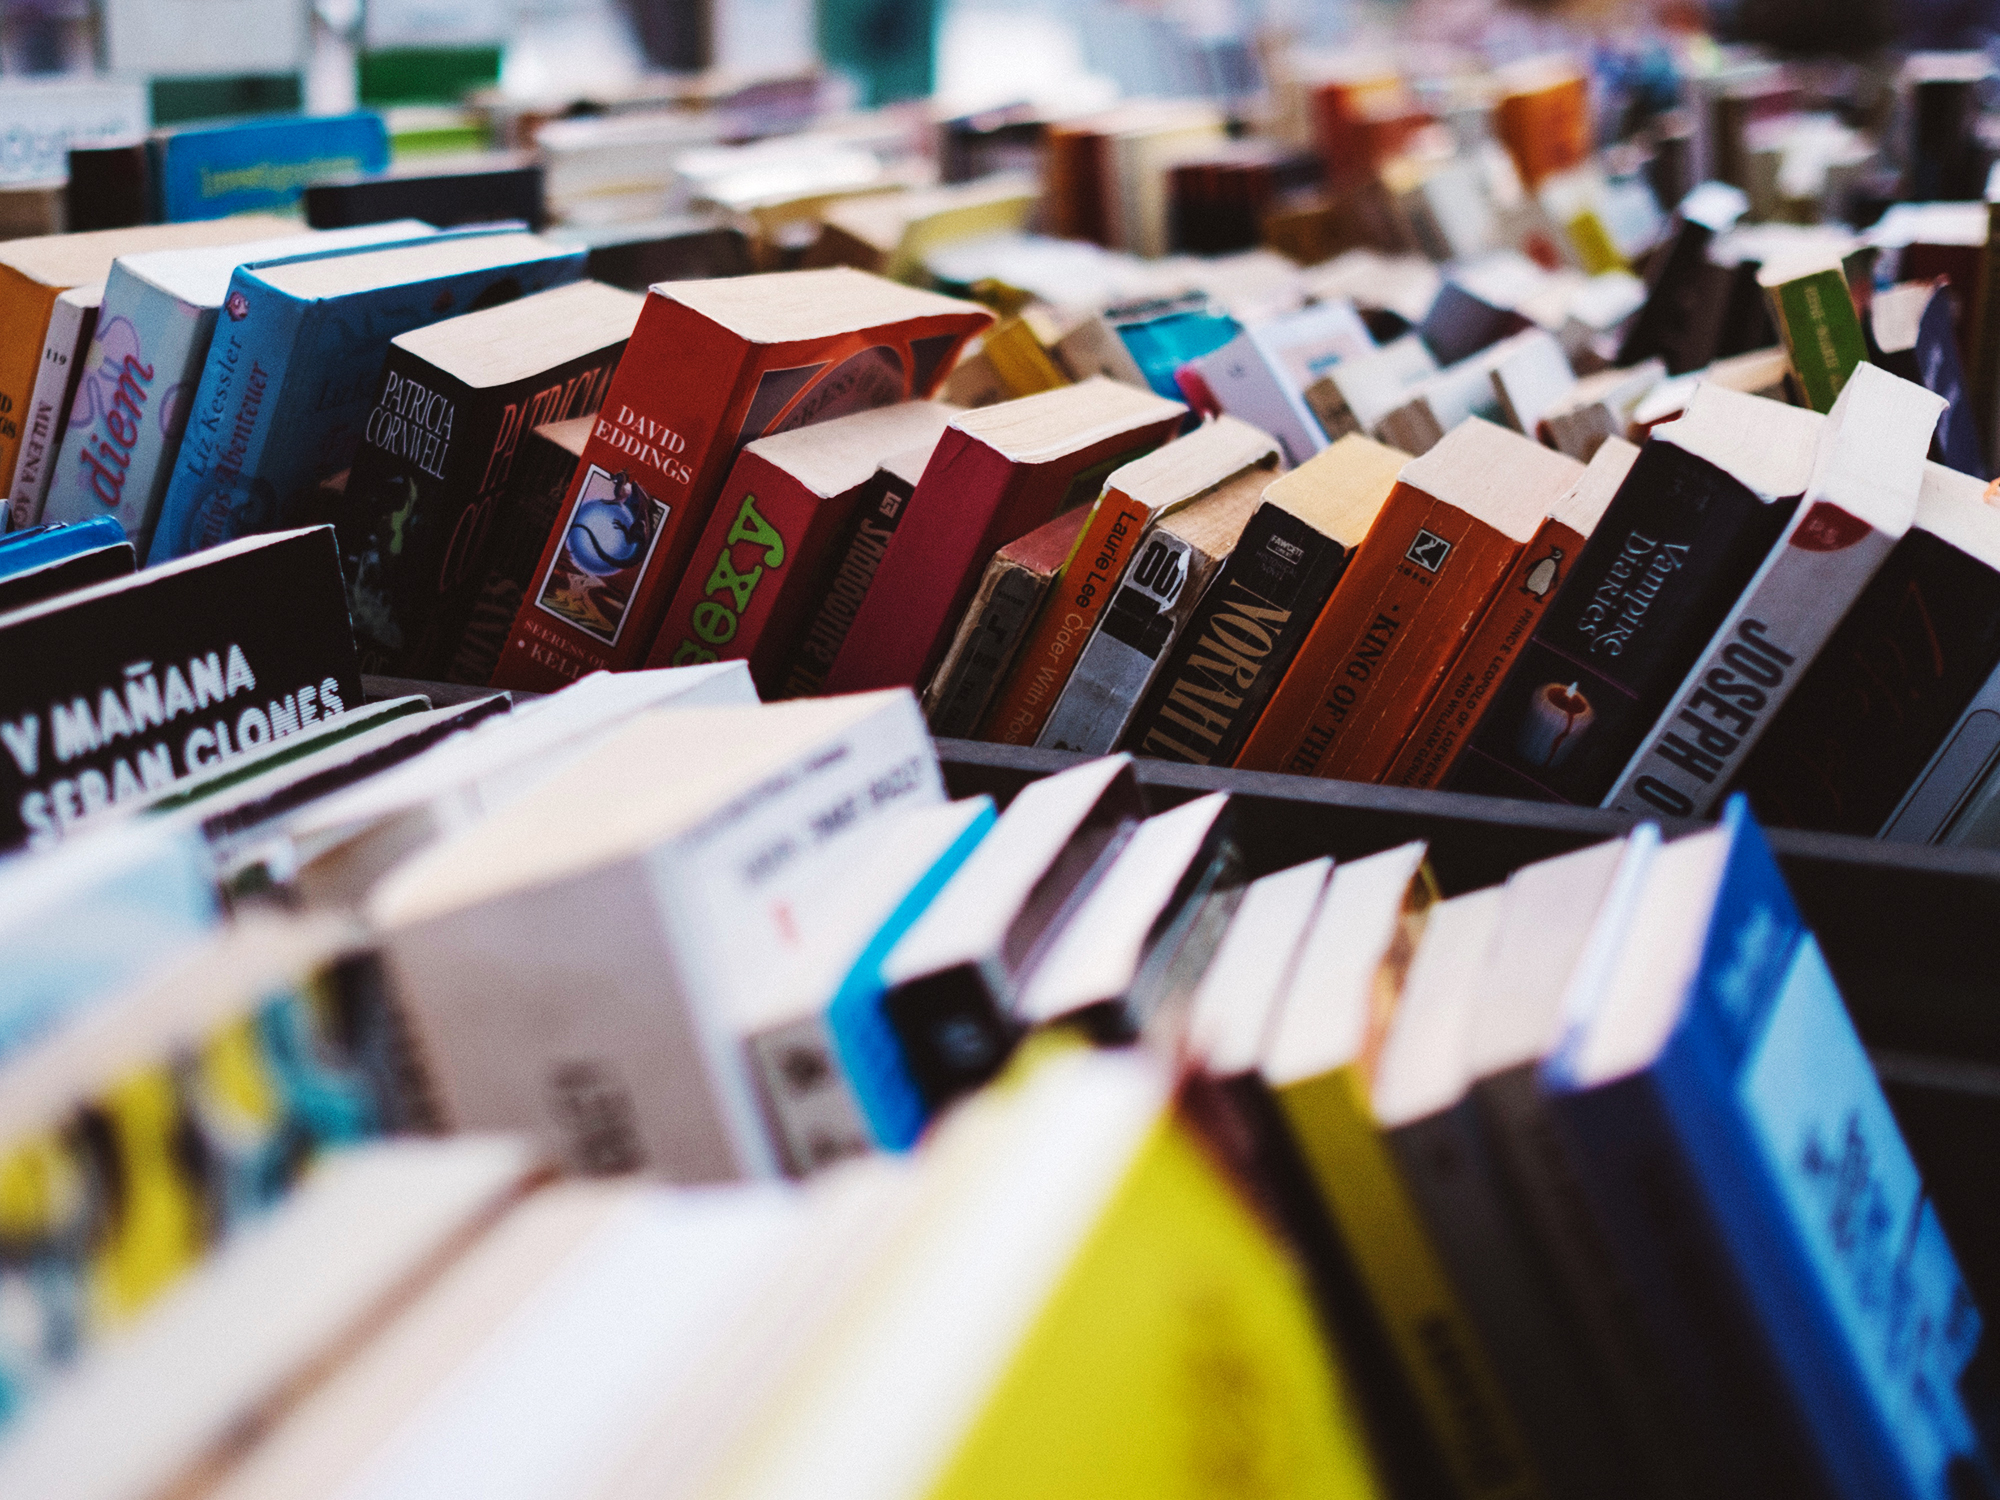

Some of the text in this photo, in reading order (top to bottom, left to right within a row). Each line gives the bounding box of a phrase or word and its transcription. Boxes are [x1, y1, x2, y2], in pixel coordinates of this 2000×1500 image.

[46, 348, 67, 366] 119
[80, 354, 154, 507] diem
[187, 335, 242, 477] Liz Kessler
[215, 361, 268, 487] Abenteuer
[382, 371, 454, 440] PATRICIA
[617, 404, 686, 454] DAVID
[21, 400, 53, 484] MILENA
[366, 407, 449, 480] CORNWELL
[595, 418, 693, 485] EDDINGS
[1076, 510, 1138, 609] Laurie Lee
[1578, 531, 1658, 636] Diaries
[1501, 608, 1534, 654] PRINCE
[1590, 543, 1691, 656] Vampire
[1052, 613, 1091, 663] Cider
[1160, 578, 1292, 746] NORAH
[1345, 612, 1400, 682] KING
[0, 643, 256, 776] Y MAÑANA
[1023, 667, 1057, 709] With
[1325, 684, 1357, 724] OF
[1454, 672, 1475, 698] AND
[1465, 655, 1504, 710] LEOPOLD
[1653, 618, 1797, 784] JOSEPH
[183, 677, 345, 772] CLONES
[1424, 698, 1461, 748] WILLIAM
[1455, 711, 1470, 728] OF
